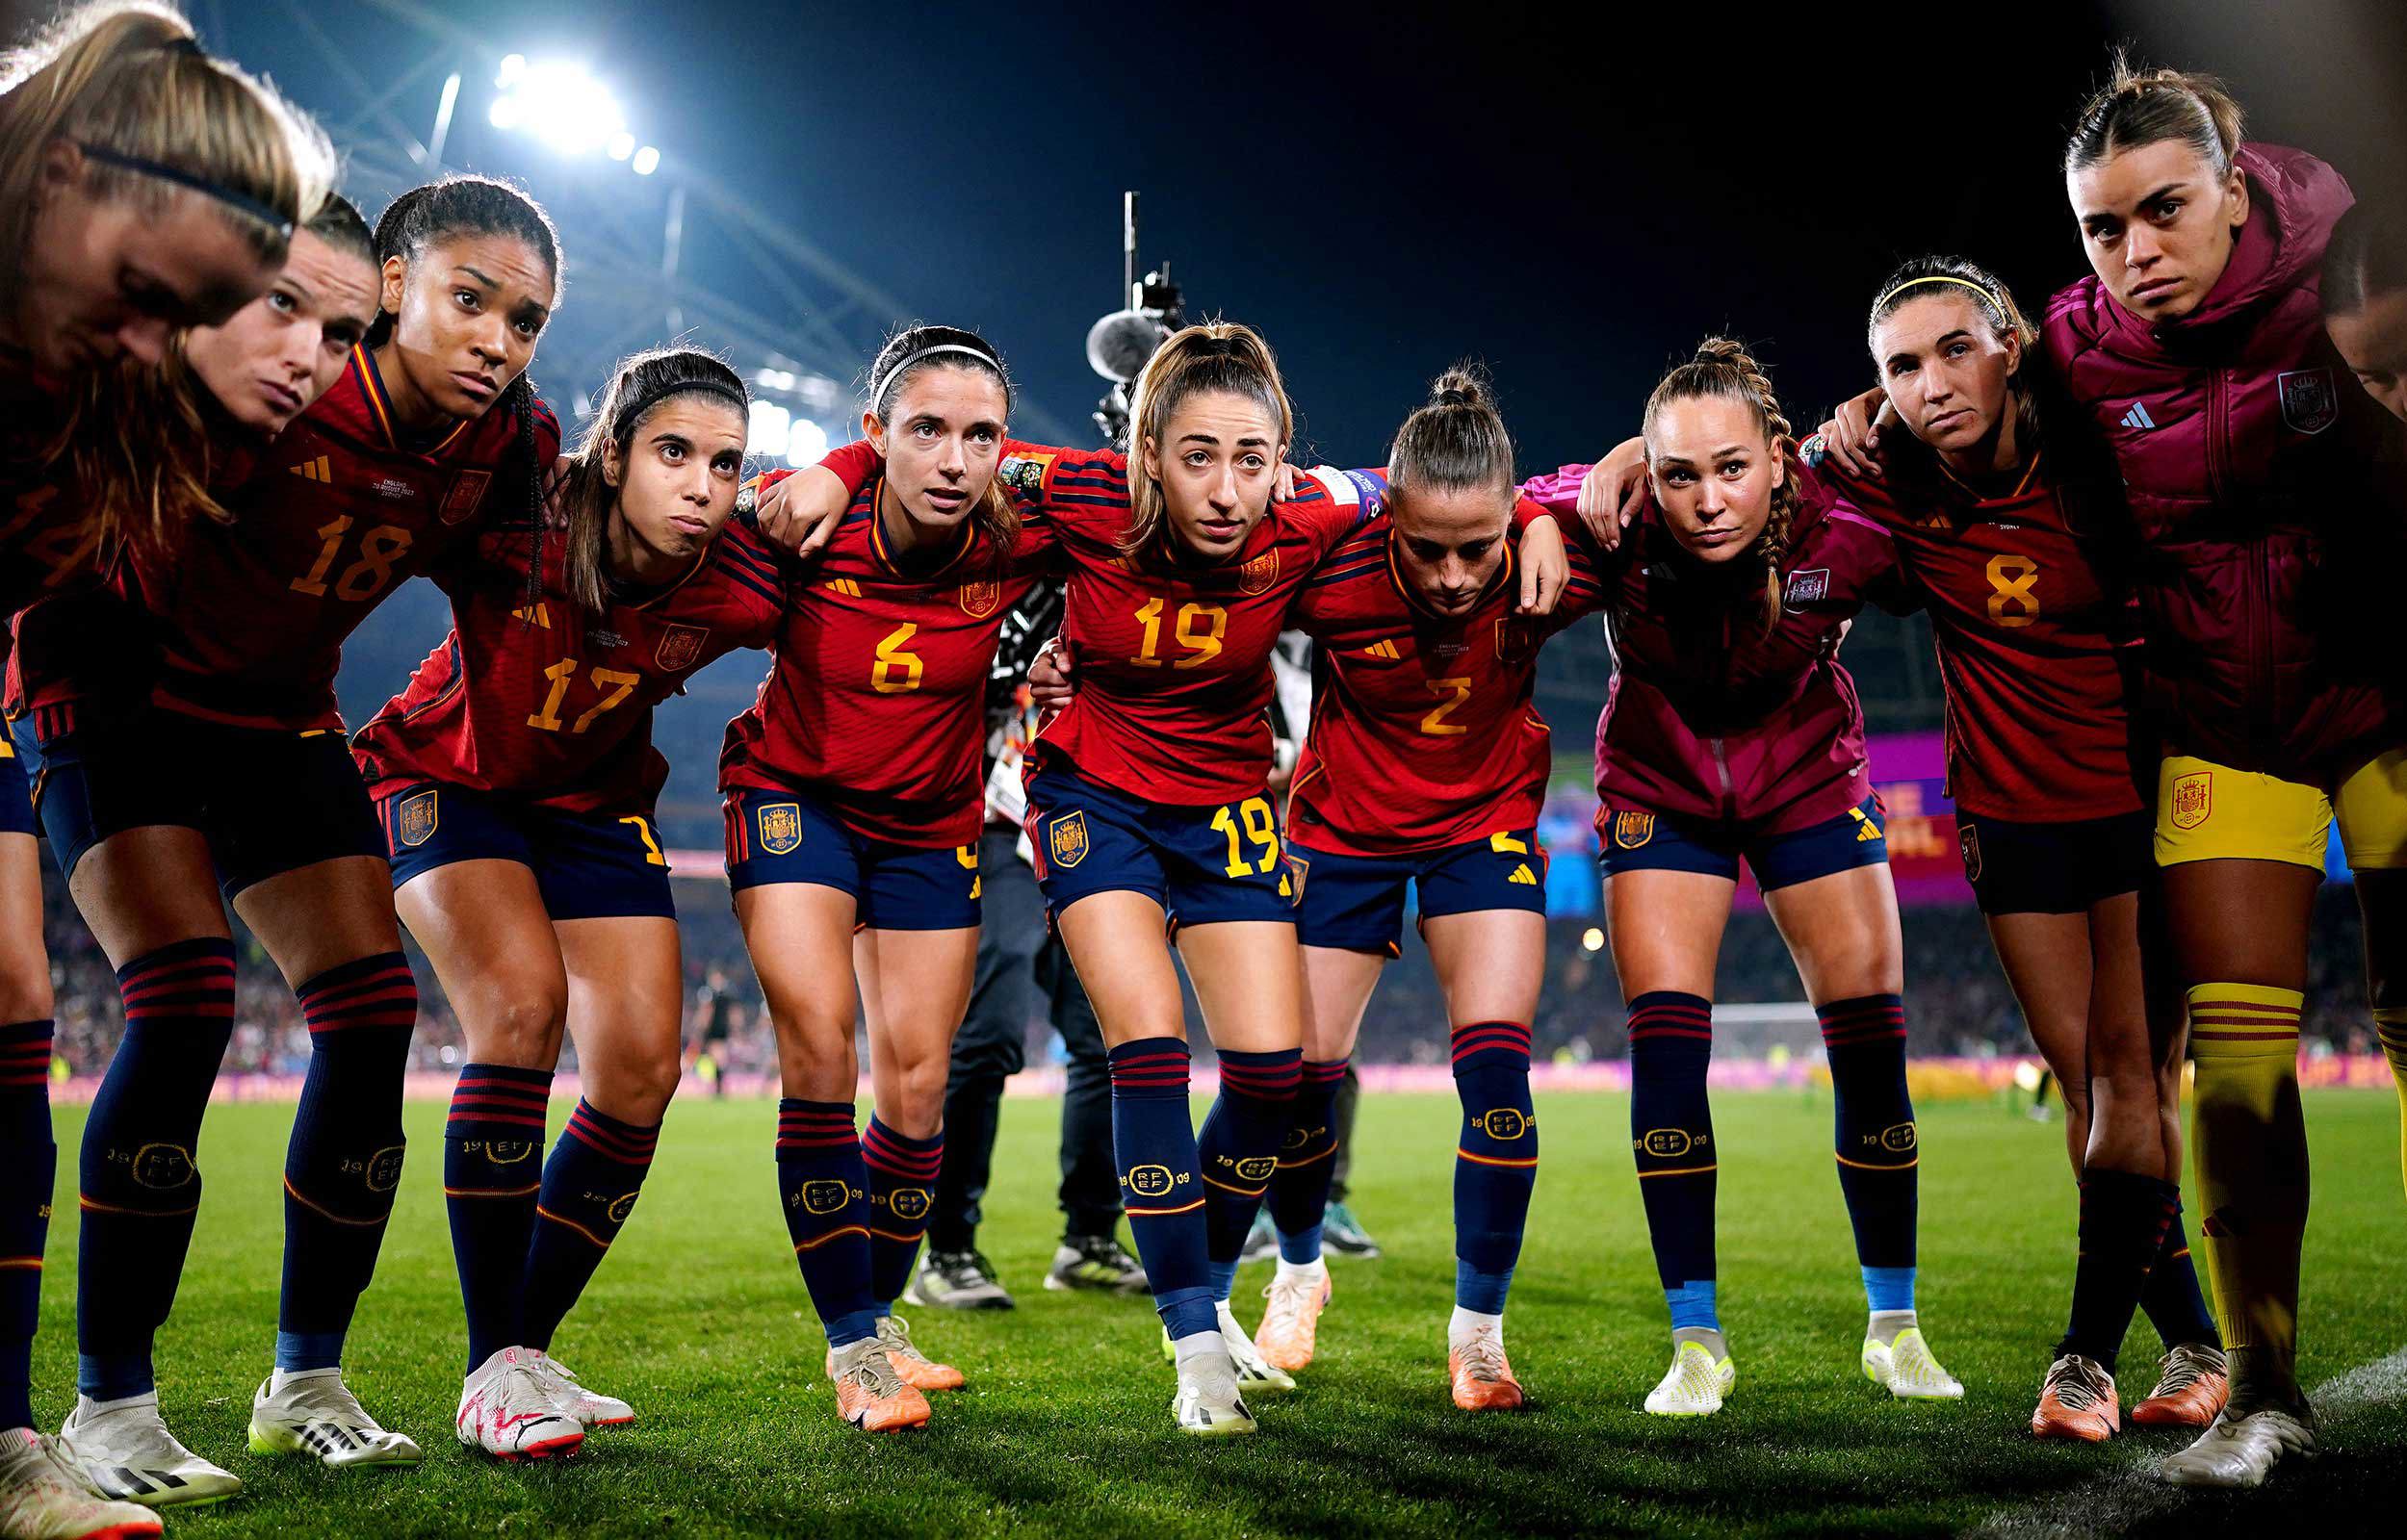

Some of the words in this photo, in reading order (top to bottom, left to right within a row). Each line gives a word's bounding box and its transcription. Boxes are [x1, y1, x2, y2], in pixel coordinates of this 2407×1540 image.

[290, 514, 412, 602] 18
[1986, 554, 2039, 628] 8
[870, 622, 924, 694] 6
[1129, 598, 1228, 670] 19
[527, 657, 640, 733] 17
[1421, 677, 1471, 734] 2
[1209, 796, 1280, 878] 19
[851, 1188, 864, 1200] 09
[1177, 1171, 1190, 1184] 09
